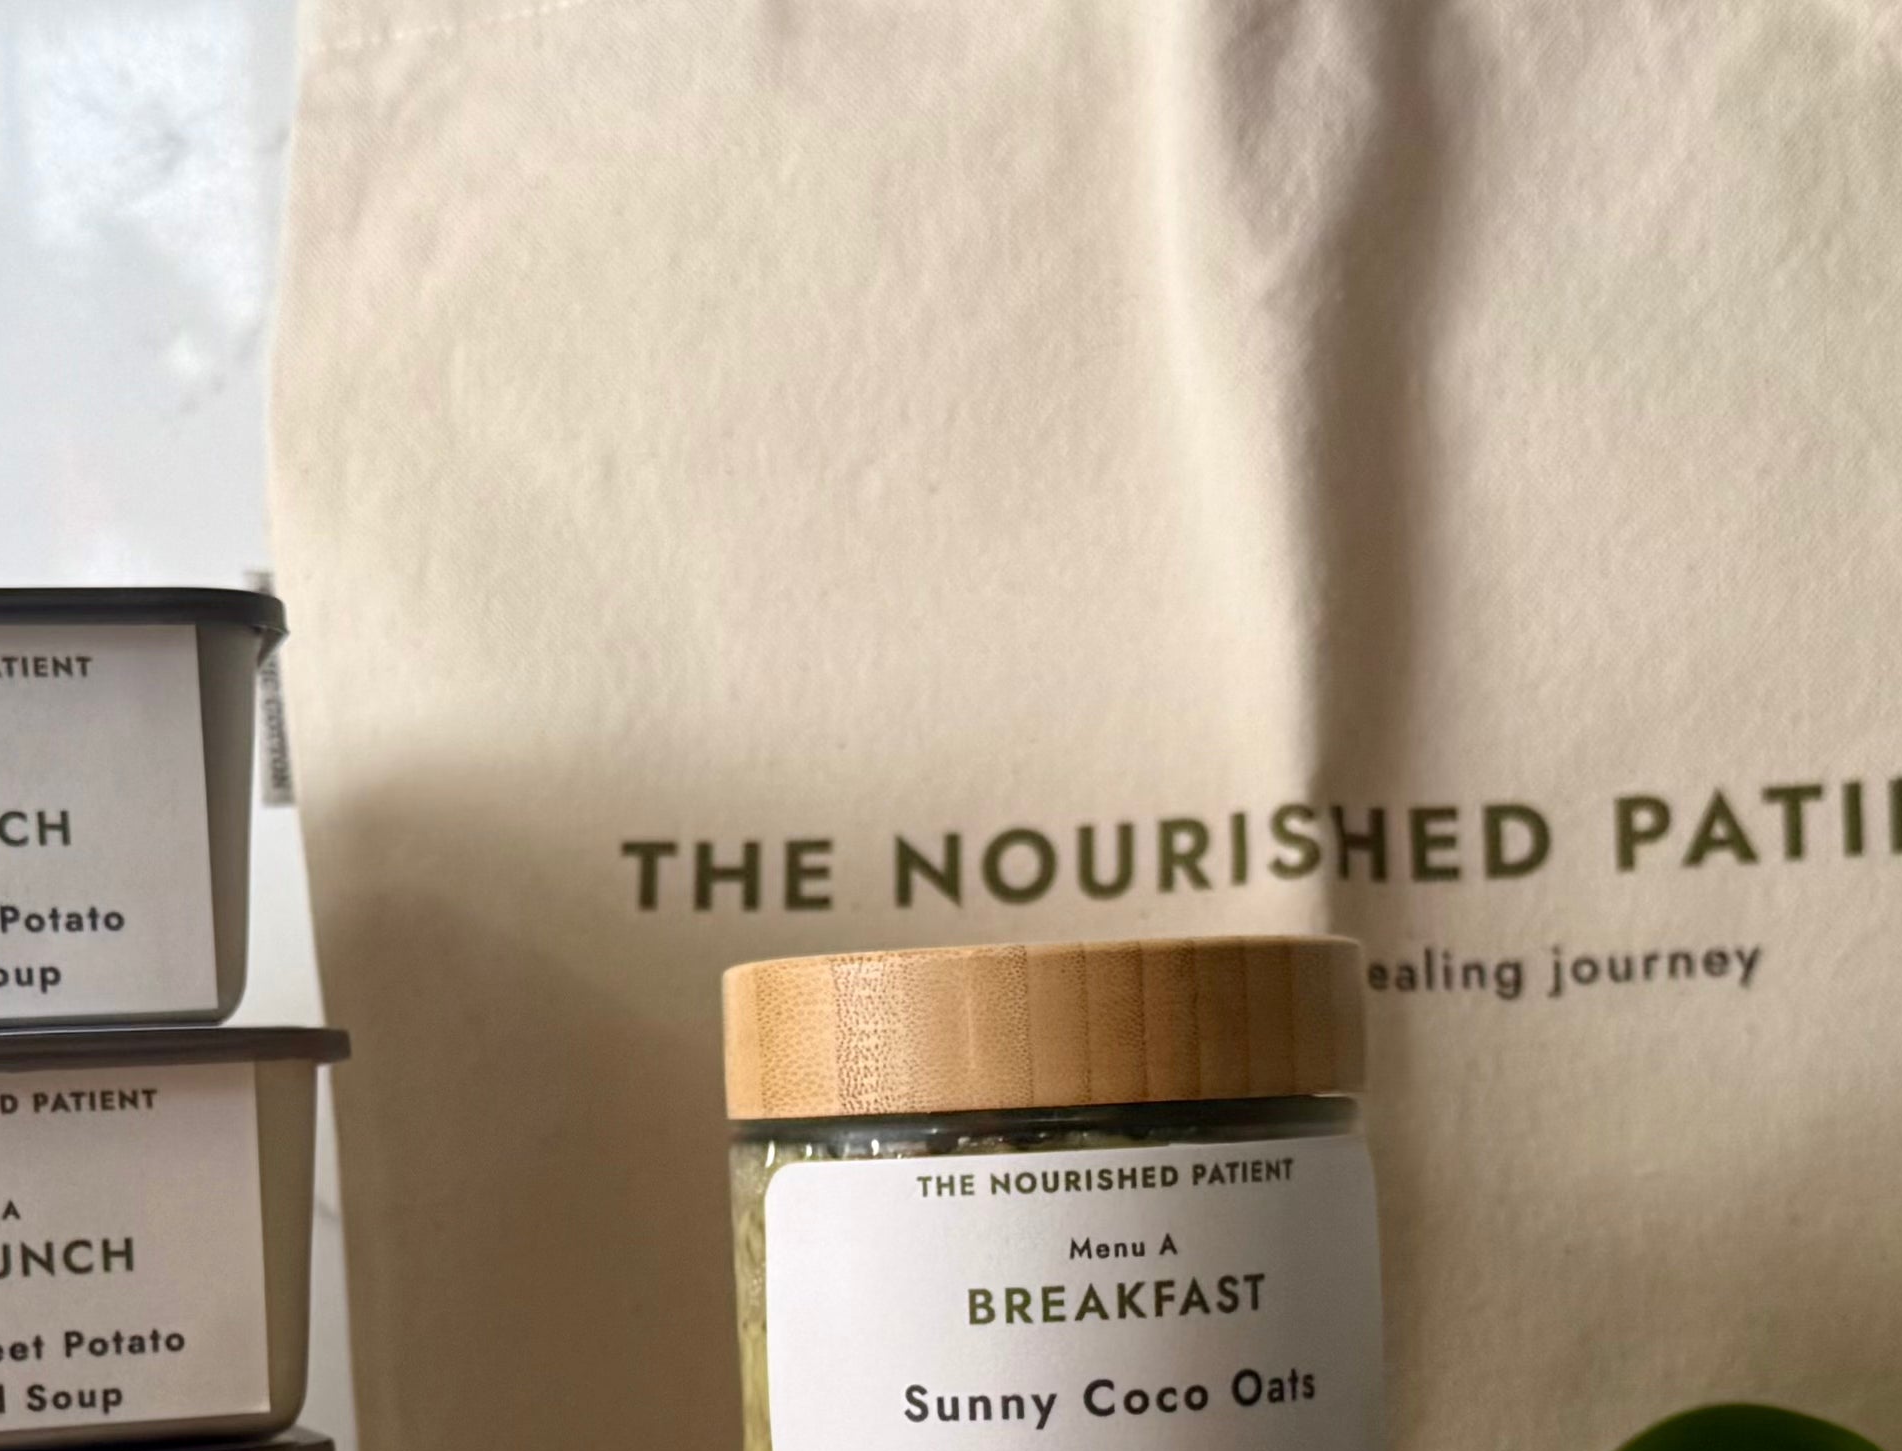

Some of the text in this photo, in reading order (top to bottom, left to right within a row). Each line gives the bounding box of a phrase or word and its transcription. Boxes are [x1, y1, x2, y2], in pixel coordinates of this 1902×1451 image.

[621, 838, 833, 911] THE
[894, 801, 1553, 909] NOURISHED
[0, 905, 124, 933] Potato
[1368, 946, 1762, 1001] ealing journey
[917, 1158, 1293, 1197] THE NOURISHED PATIENT
[1070, 1234, 1177, 1259] Menu A
[968, 1274, 1264, 1325] BREAKFAST
[64, 1329, 184, 1358] Potato
[27, 1384, 122, 1414] Soup
[905, 1369, 1314, 1429] Sunny Coco Oats
